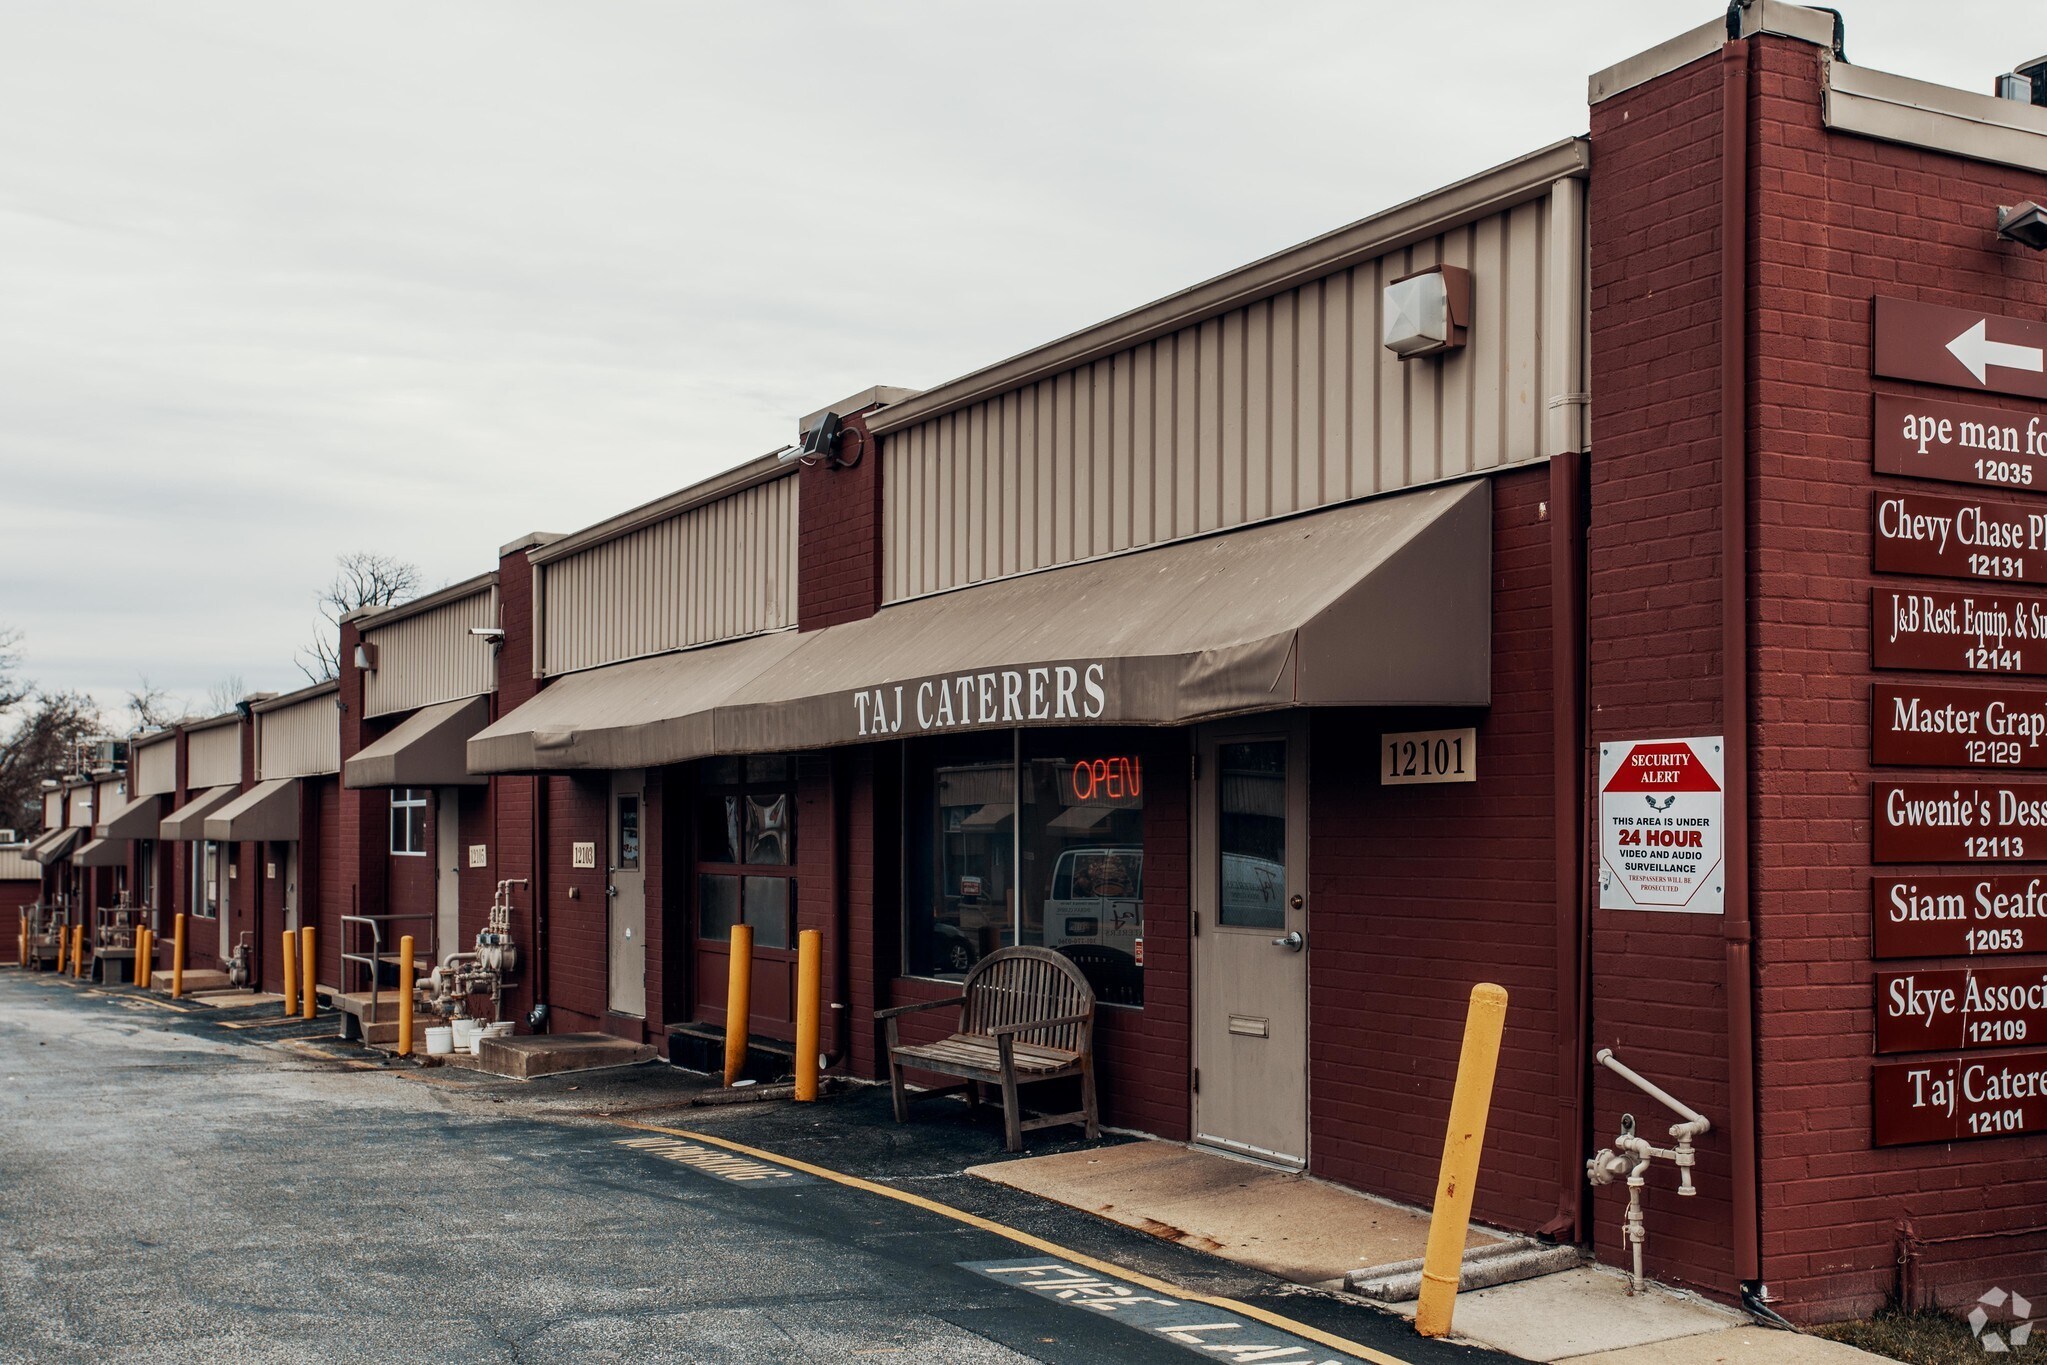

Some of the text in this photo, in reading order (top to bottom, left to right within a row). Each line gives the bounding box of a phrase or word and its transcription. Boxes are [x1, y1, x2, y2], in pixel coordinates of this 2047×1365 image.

[1903, 414, 1952, 454] ape
[1959, 421, 2020, 453] man
[1974, 459, 2033, 485] 12035
[1879, 499, 1952, 555] Chevy
[1956, 506, 2023, 549] Chase
[1968, 554, 2023, 578] 12131
[1890, 594, 1920, 643] J&B
[1923, 596, 1960, 634] Rest.
[1963, 599, 2012, 649] Equip.
[2015, 602, 2028, 640] &
[1965, 648, 2021, 671] 12141
[854, 663, 1105, 735] TAJ CATERERS
[1891, 697, 2047, 748] Master Grap
[1389, 737, 1465, 777] 12101
[1631, 753, 1690, 766] SECURITY
[1965, 741, 2021, 764] 12129
[1073, 756, 1140, 800] OPEN
[1641, 771, 1680, 783] ALERT
[1887, 788, 1991, 826] Gwenie's
[1613, 817, 1710, 826] THIS AREA IS UNDER
[1618, 829, 1703, 848] 24 HOUR
[1964, 837, 2024, 857] 12113
[575, 847, 593, 864] 12103
[1620, 850, 1702, 860] VIDEO AND AUDIO
[1625, 862, 1696, 873] SURVEILLANCE
[1629, 875, 1667, 883] TRESPASSERS
[1684, 876, 1692, 884] BE
[1641, 884, 1679, 892] PROSECUTED
[1889, 884, 1967, 922] Siam
[1965, 927, 2024, 951] 12053
[1889, 975, 2047, 1028] Skye Associ
[1969, 1019, 2027, 1043] 12109
[1907, 1069, 1955, 1118] Taj
[1968, 1108, 2024, 1134] 12101
[986, 1264, 1181, 1311] FIRE
